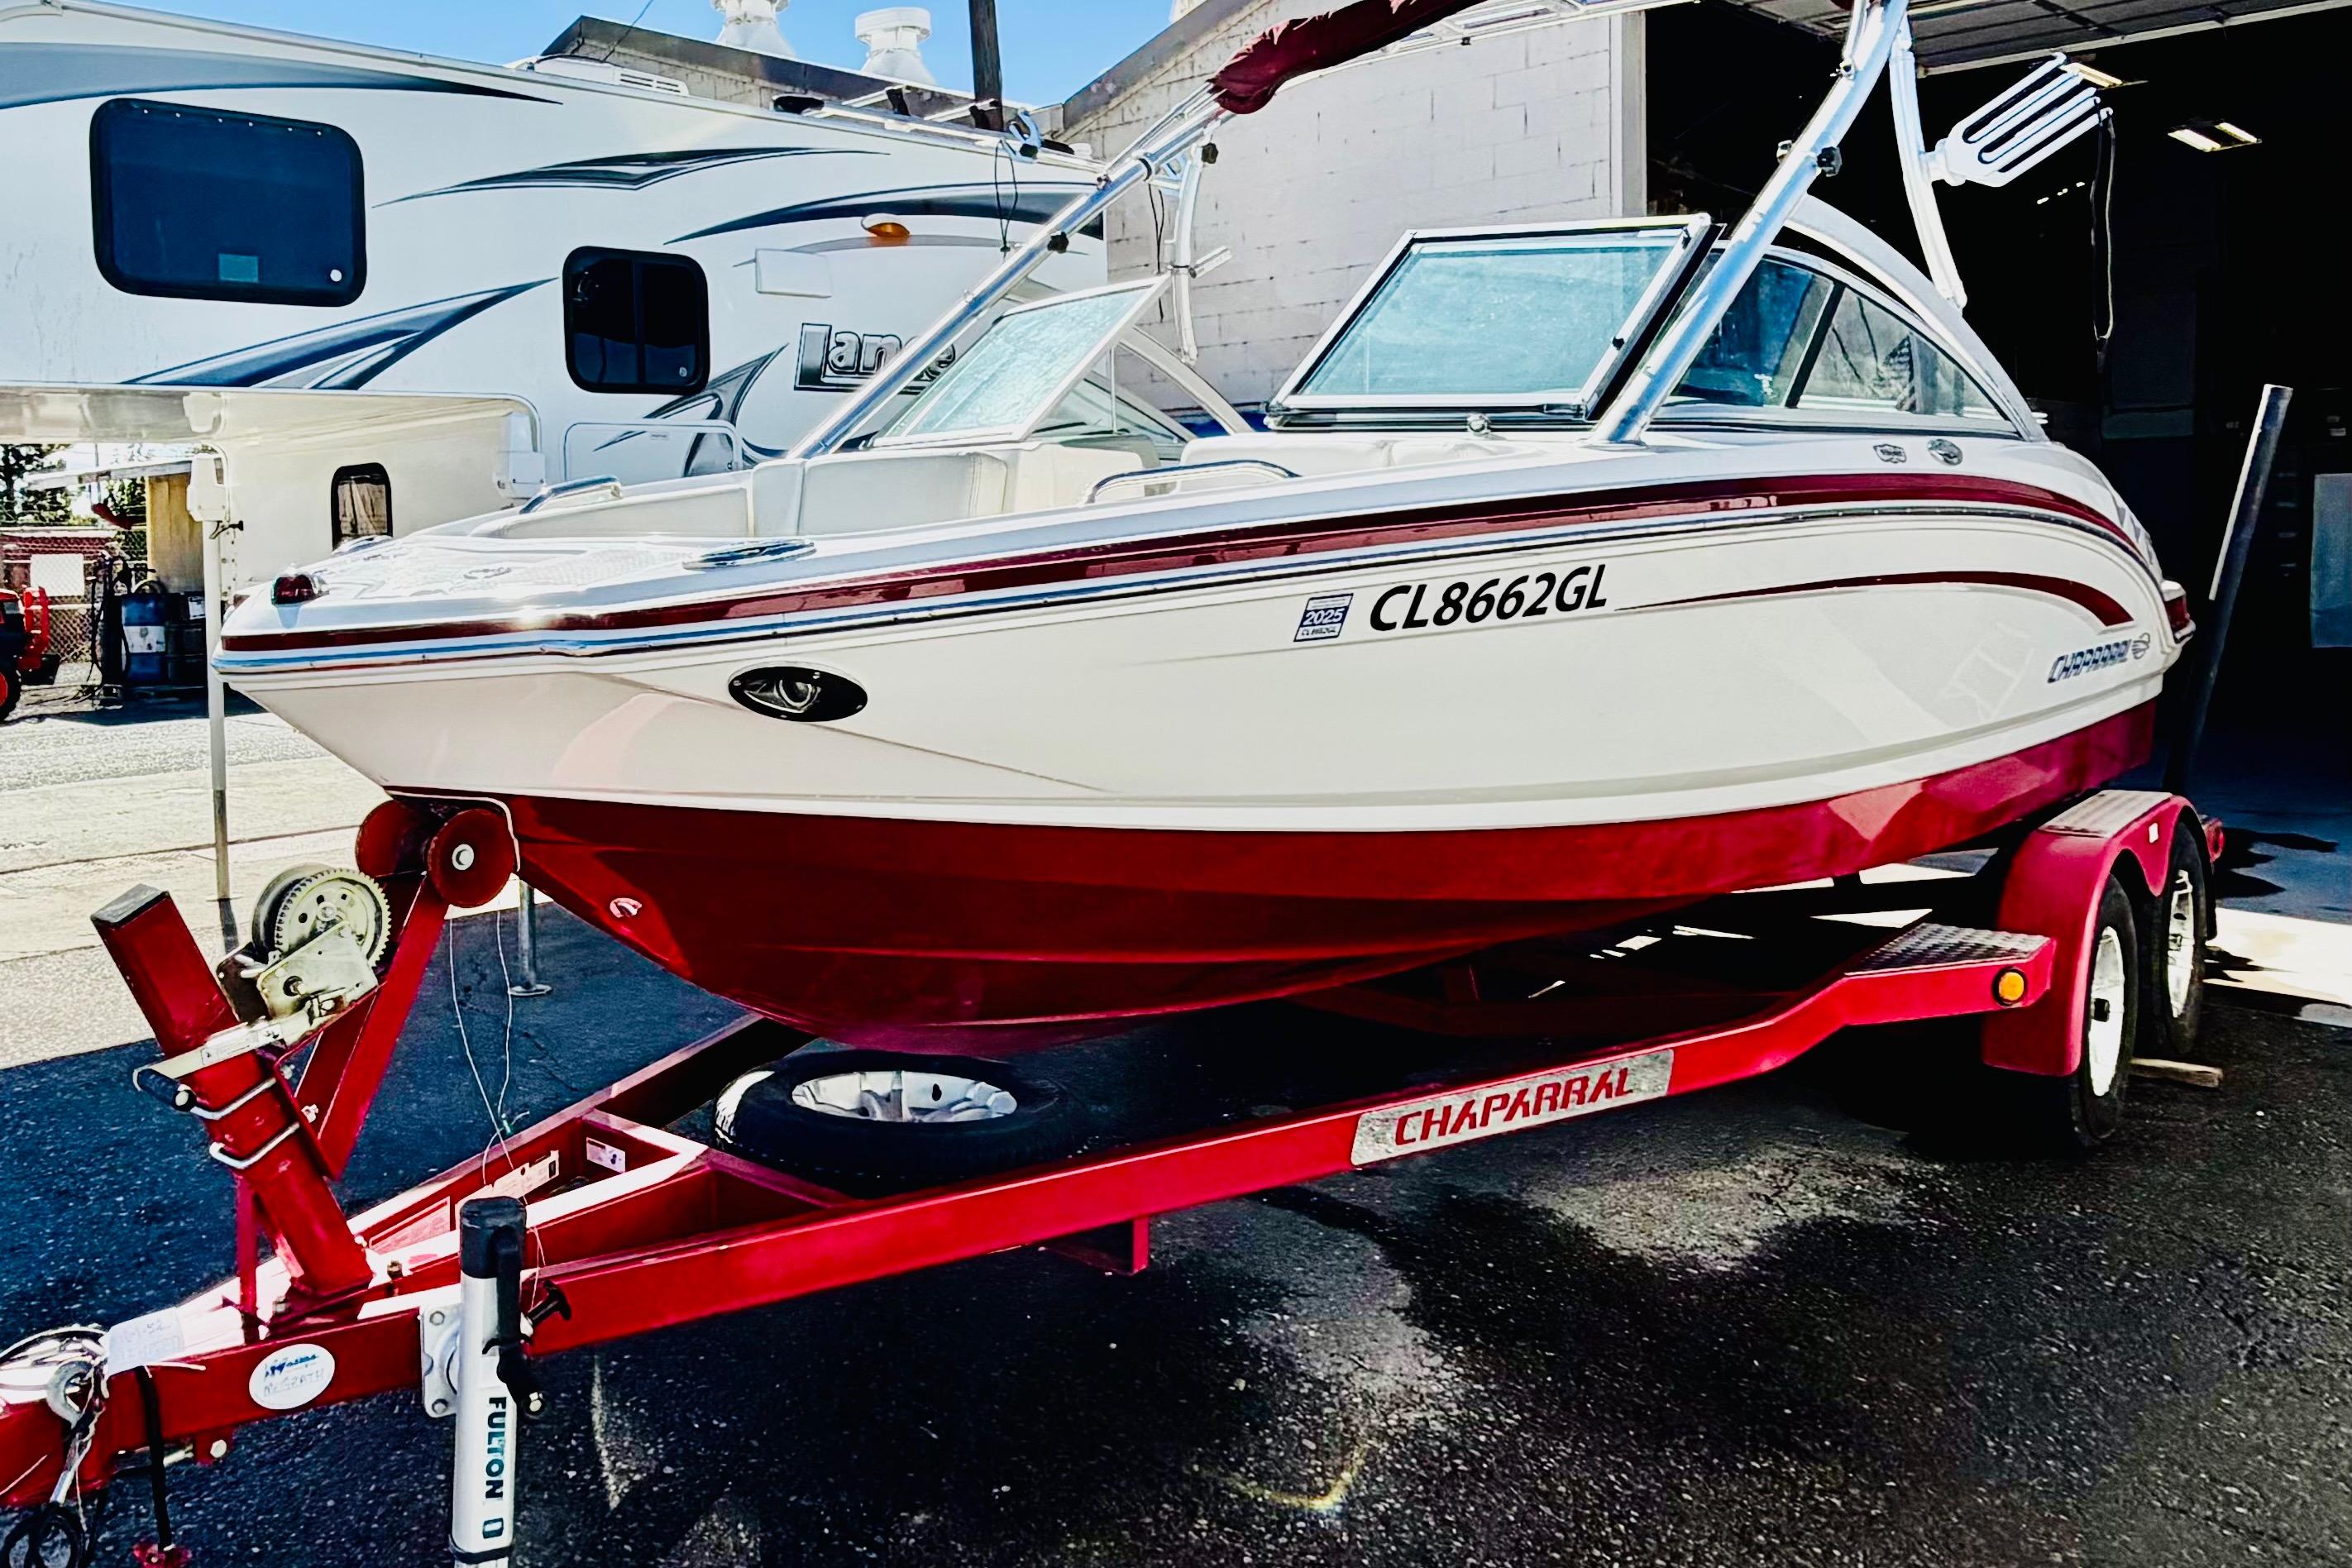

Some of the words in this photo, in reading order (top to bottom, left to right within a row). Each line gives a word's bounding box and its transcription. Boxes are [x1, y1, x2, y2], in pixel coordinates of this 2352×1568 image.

[1303, 608, 1346, 625] 2025
[1370, 564, 1607, 631] CL8662GL
[1395, 1067, 1633, 1146] CHAPARRAL
[485, 1397, 507, 1499] FULTON
